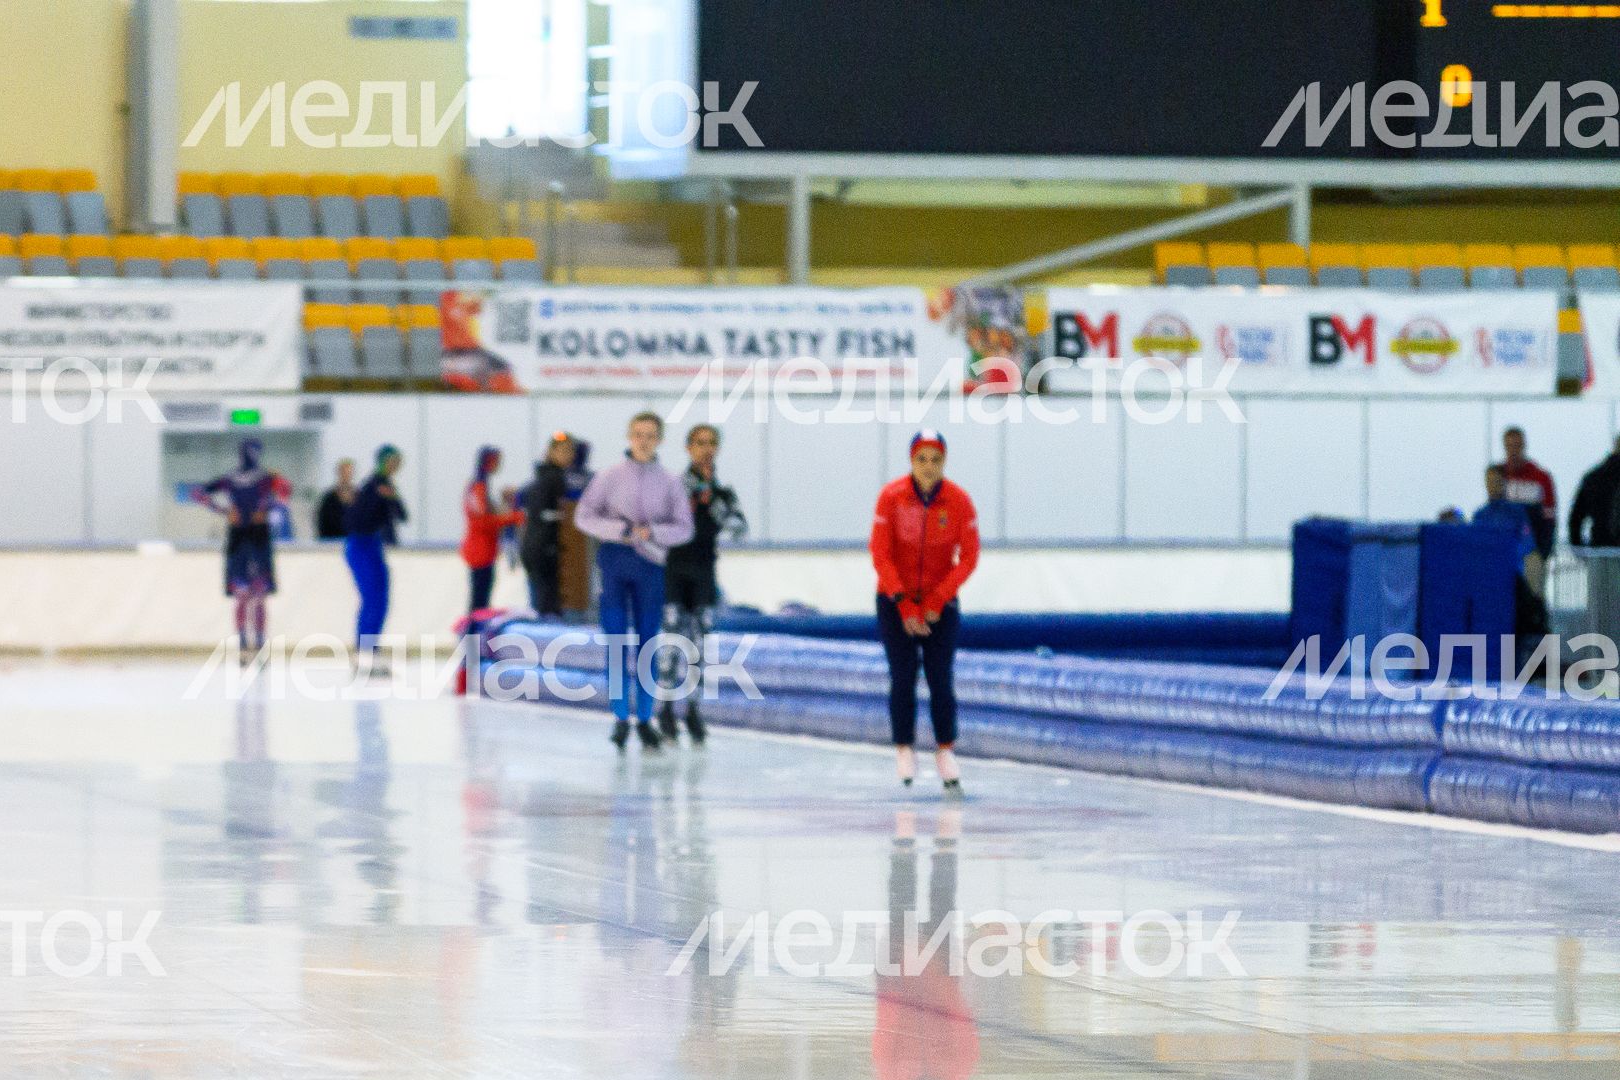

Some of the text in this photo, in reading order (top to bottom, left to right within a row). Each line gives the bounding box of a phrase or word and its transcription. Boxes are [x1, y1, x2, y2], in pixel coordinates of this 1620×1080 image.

[537, 328, 916, 358] KOLOMNA TASTY FISH
